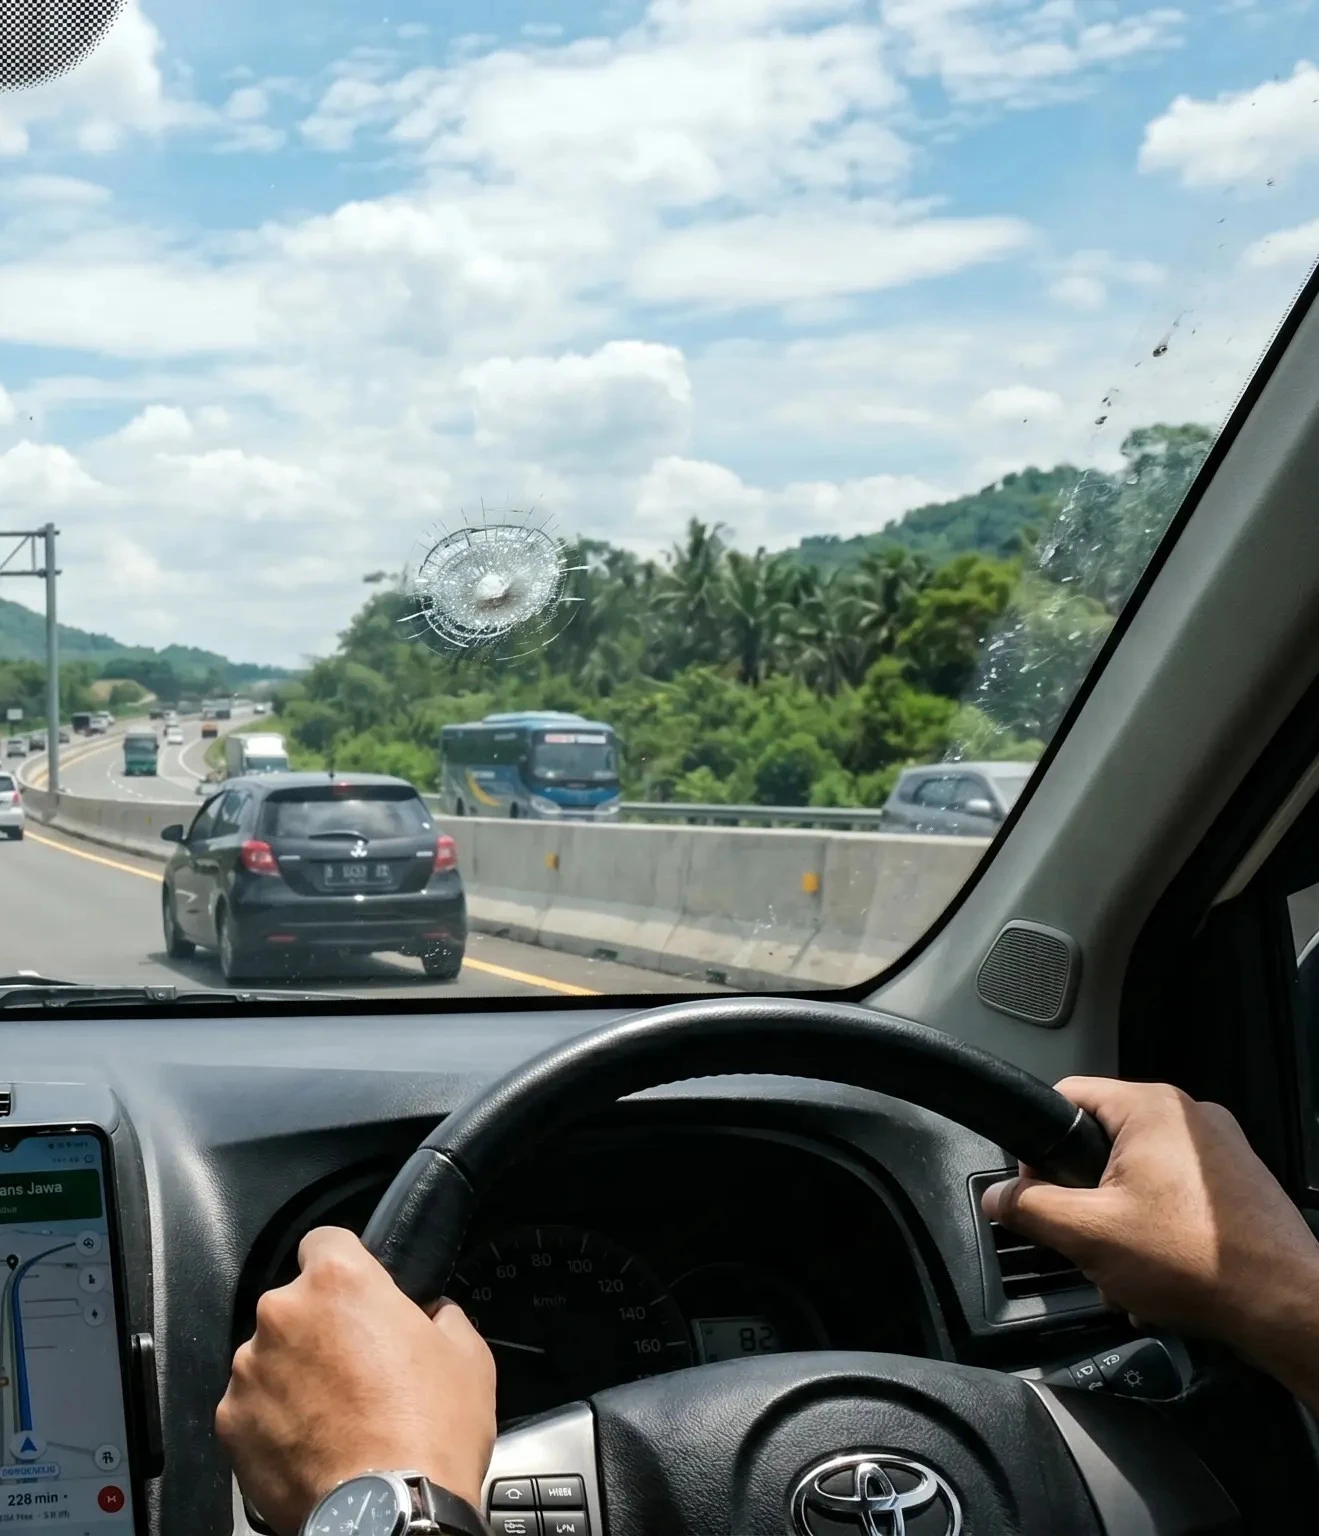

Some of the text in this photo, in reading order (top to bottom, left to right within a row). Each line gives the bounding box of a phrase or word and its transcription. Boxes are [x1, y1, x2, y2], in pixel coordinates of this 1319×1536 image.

[27, 1181, 63, 1196] Jawa
[531, 1253, 553, 1267] 80
[567, 1259, 593, 1274] 100
[496, 1264, 517, 1279] 60
[471, 1287, 492, 1301] 40
[598, 1279, 624, 1294] 120
[532, 1294, 566, 1308] km/h
[618, 1306, 646, 1321] 140
[633, 1339, 661, 1353] 160
[739, 1326, 773, 1353] 82
[8, 1492, 59, 1506] 228 min
